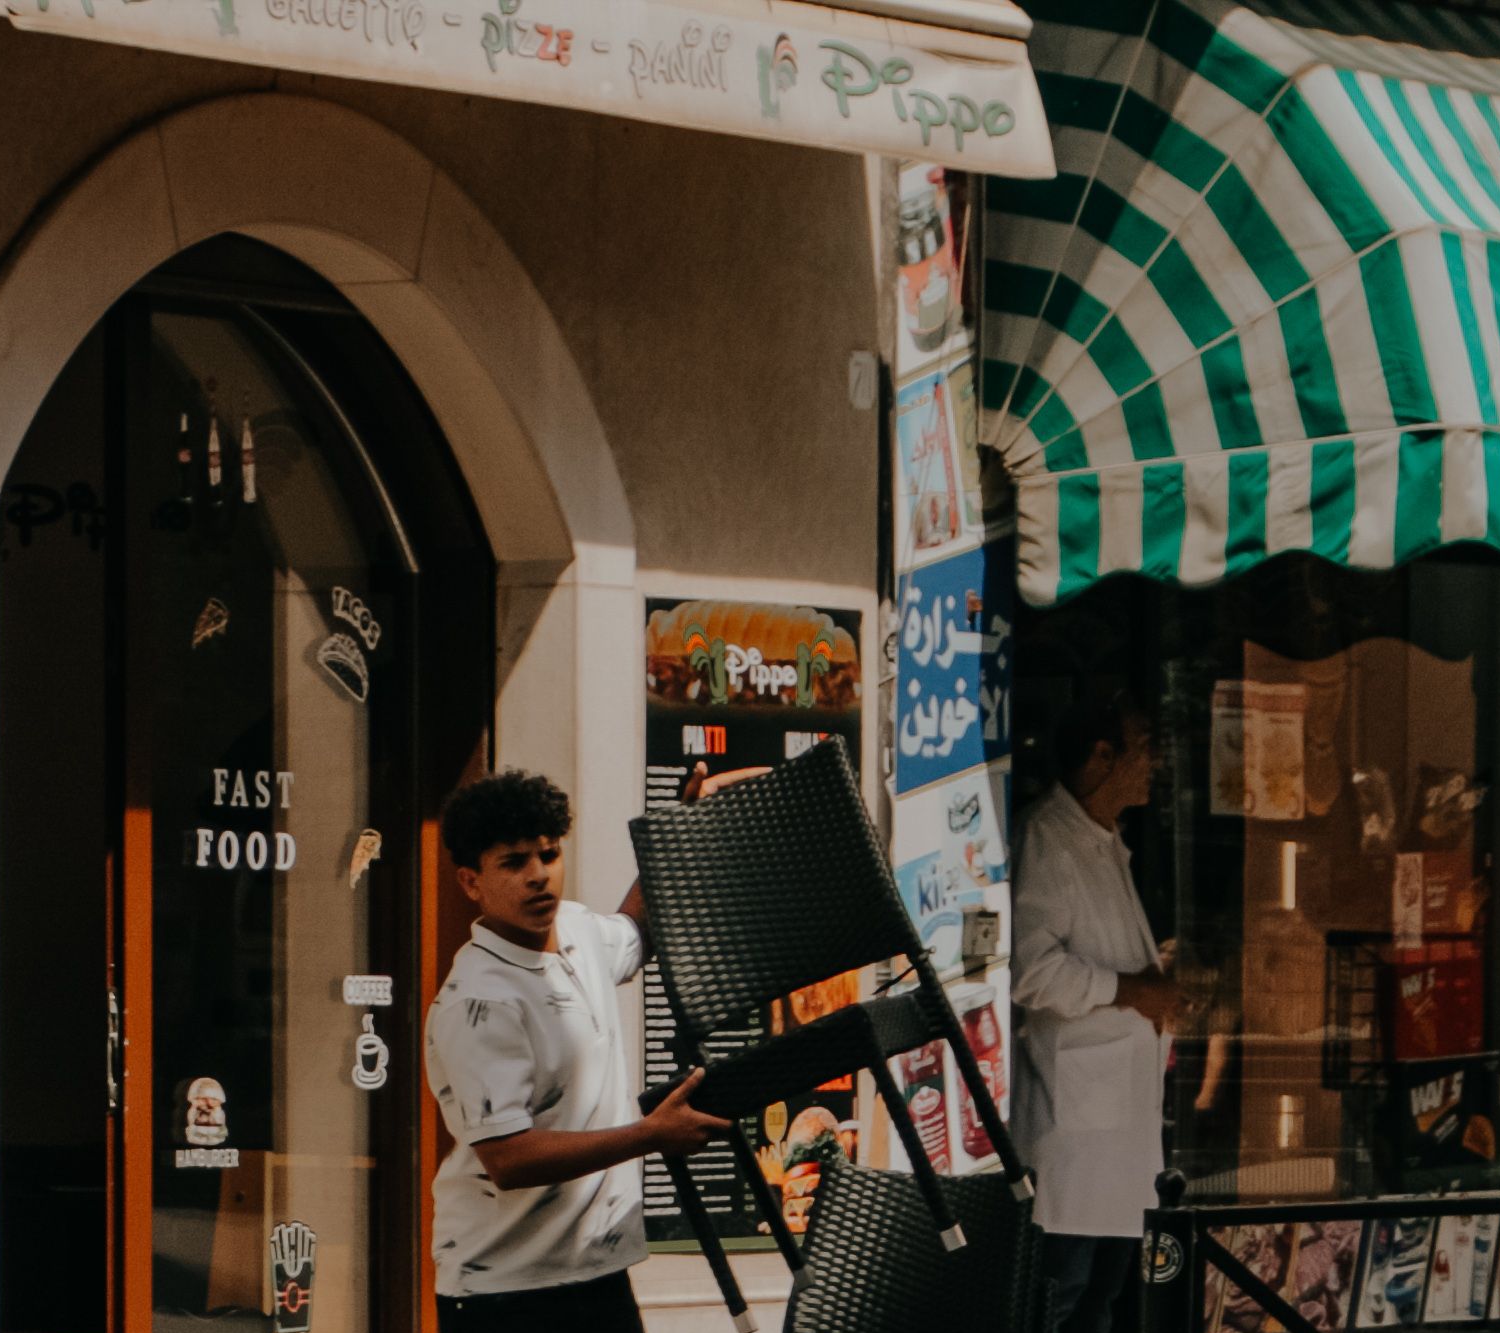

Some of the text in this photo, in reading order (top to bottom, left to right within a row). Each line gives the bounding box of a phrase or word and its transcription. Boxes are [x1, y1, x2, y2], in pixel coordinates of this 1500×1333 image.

[817, 38, 1016, 152] Pippo
[332, 586, 381, 650] TACOS
[904, 585, 1011, 671] جزارة
[725, 643, 798, 696] Pippo
[213, 768, 295, 808] FAST
[196, 828, 297, 871] FOOD
[343, 974, 393, 1006] COFFEE
[176, 1148, 239, 1168] HAMBURGER
